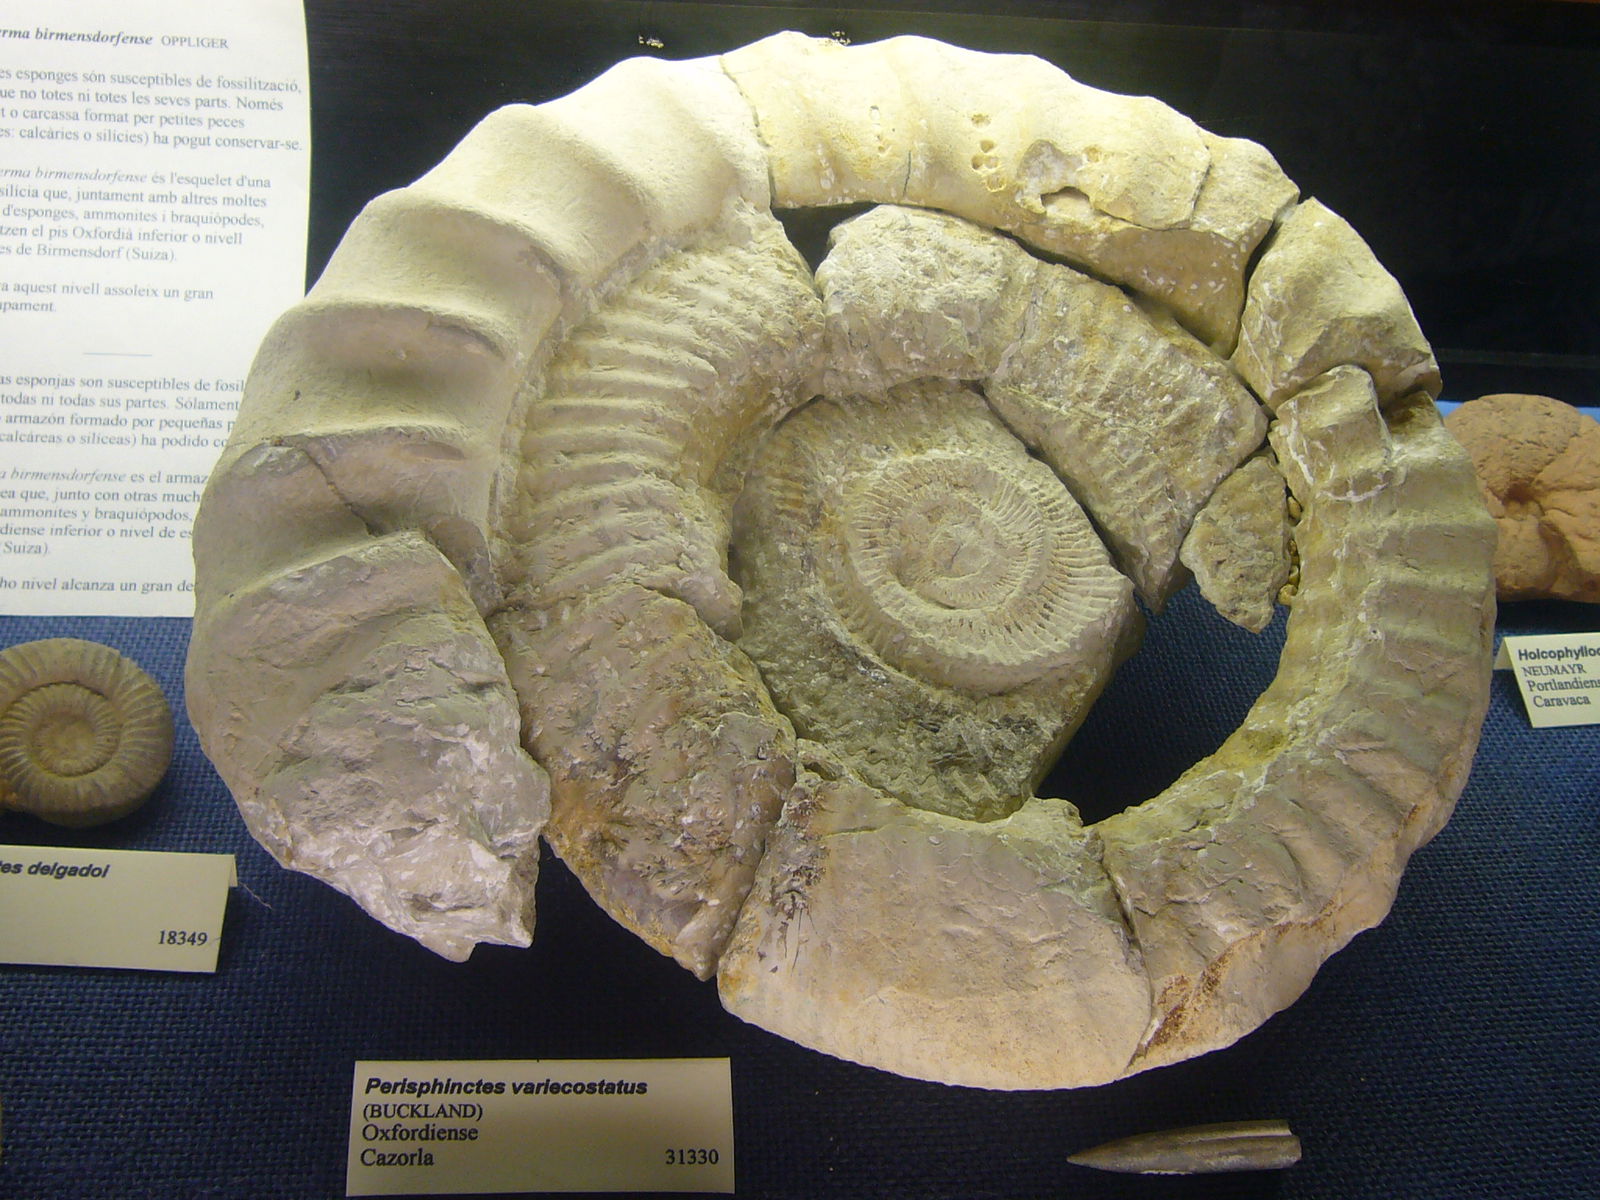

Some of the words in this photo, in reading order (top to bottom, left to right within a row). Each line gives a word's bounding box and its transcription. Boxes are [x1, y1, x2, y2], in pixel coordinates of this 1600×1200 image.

[34, 26, 154, 49] birmensdorfense
[160, 34, 229, 50] OPPLIGER
[15, 69, 79, 85] esponges
[82, 70, 106, 84] són
[110, 72, 193, 89] susceptibles
[195, 74, 213, 89] de
[216, 75, 302, 95] fossilització,
[19, 89, 37, 100] no
[40, 88, 74, 102] totes
[77, 88, 90, 103] ni
[94, 90, 128, 104] totes
[132, 90, 151, 106] les
[154, 95, 191, 107] seves
[236, 95, 284, 112] Només
[9, 108, 19, 119] o
[22, 108, 80, 122] carcassa
[84, 107, 129, 124] format
[133, 113, 155, 127] per
[159, 112, 204, 128] petites
[207, 117, 245, 131] peces
[18, 124, 80, 142] calcàries
[83, 130, 92, 142] o
[153, 130, 170, 145] ha
[173, 135, 211, 150] pogut
[214, 136, 302, 151] conservar-se.
[34, 165, 147, 185] birmensdorfense
[170, 171, 232, 189] l'esquelet
[235, 174, 271, 189] d'una
[77, 187, 143, 202] juntament
[147, 190, 178, 204] amb
[181, 191, 218, 206] altres
[222, 192, 267, 208] moltes
[2, 203, 79, 222] d'esponges,
[83, 210, 158, 223] ammonites
[0, 223, 28, 237] tzen
[31, 223, 45, 238] el
[48, 225, 70, 241] pis
[72, 226, 134, 241] Oxfordià
[138, 228, 189, 243] inferior
[191, 233, 202, 244] o
[205, 229, 244, 244] nivell
[15, 242, 32, 256] de
[37, 244, 122, 258] Birmensdorf
[12, 283, 57, 297] aquest
[61, 282, 100, 296] nivell
[104, 284, 158, 298] assoleix
[163, 288, 180, 299] un
[183, 289, 214, 303] gran
[15, 375, 76, 390] esponjas
[79, 377, 103, 389] son
[107, 376, 190, 393] susceptibles
[193, 378, 211, 392] de
[0, 391, 37, 406] todas
[42, 394, 54, 405] ni
[59, 392, 96, 408] todas
[99, 397, 122, 409] sus
[5, 412, 65, 425] armazón
[70, 412, 128, 428] formado
[131, 417, 155, 431] por
[159, 417, 222, 432] pequeñas
[0, 429, 63, 444] calcáreas
[66, 434, 76, 445] o
[141, 433, 157, 447] ha
[161, 433, 209, 450] podido
[10, 466, 126, 485] birmensdorfense
[130, 473, 145, 484] es
[148, 470, 162, 484] el
[54, 489, 91, 504] junto
[94, 491, 120, 503] con
[123, 490, 158, 503] otras
[162, 490, 201, 502] much
[81, 509, 90, 523] y
[95, 507, 192, 524] braquiópodos,
[49, 523, 103, 537] inferior
[106, 527, 116, 538] o
[119, 525, 154, 539] nivel
[158, 525, 176, 539] de
[21, 577, 57, 591] nivel
[60, 577, 115, 592] alcanza
[119, 581, 137, 592] un
[140, 582, 173, 595] gran
[1522, 663, 1587, 677] NEUMAYR
[1533, 694, 1591, 708] Caravaca
[158, 930, 208, 946] 18349
[364, 1077, 506, 1099] Perisphinctes
[512, 1079, 649, 1096] variecostatus
[363, 1103, 484, 1122] (BUCKLAND)
[362, 1123, 479, 1142] Oxfordiense
[360, 1148, 435, 1167] Cazorla
[665, 1149, 720, 1166] 31330
